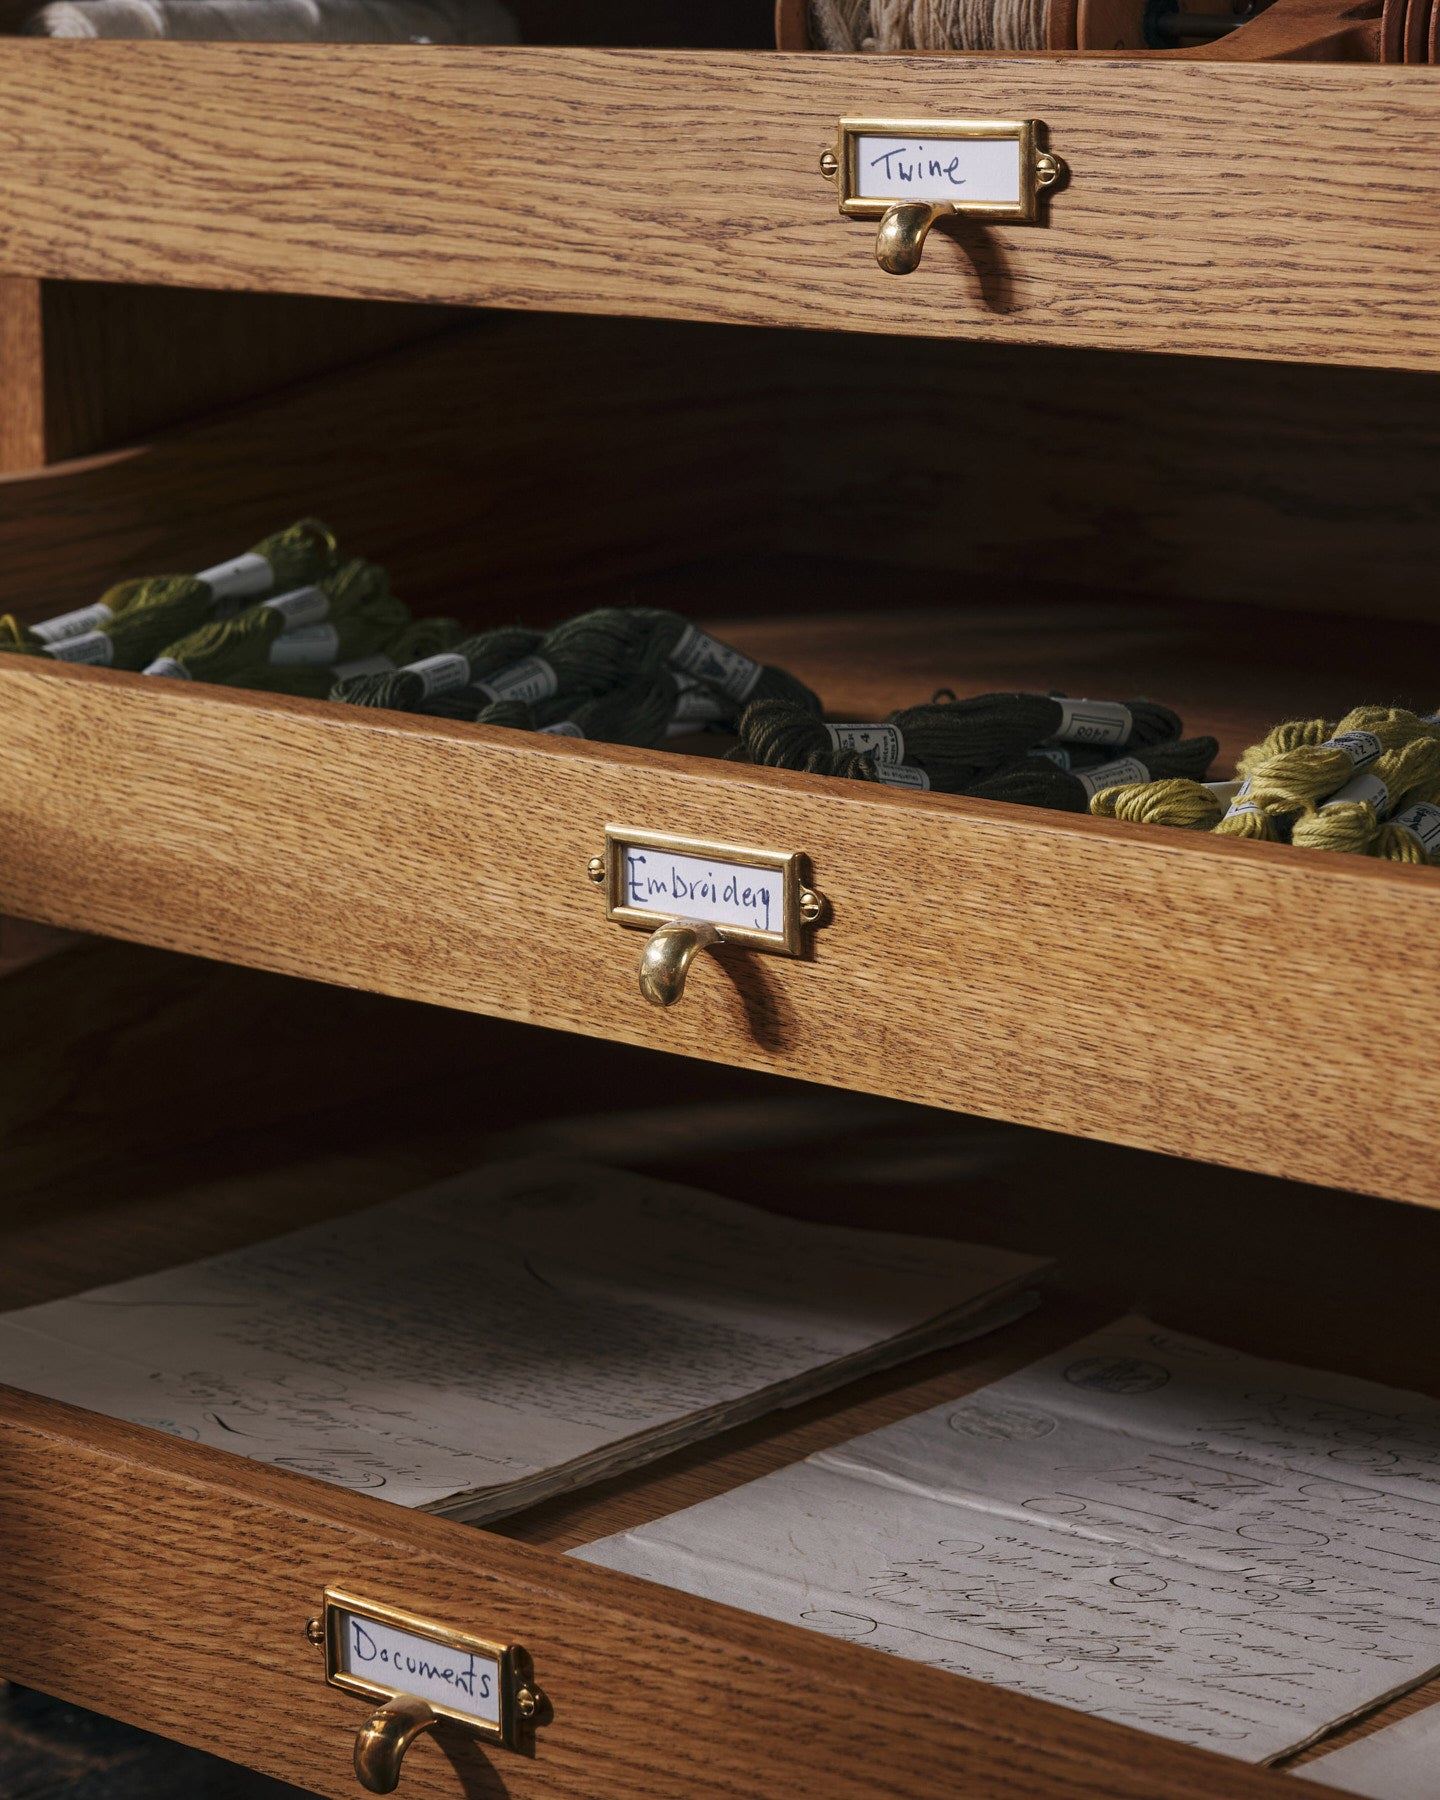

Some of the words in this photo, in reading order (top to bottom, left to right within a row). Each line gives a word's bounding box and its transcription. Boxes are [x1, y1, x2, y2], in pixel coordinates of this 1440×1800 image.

[871, 146, 966, 185] Twine
[627, 855, 770, 930] Embroidery
[351, 1620, 491, 1698] Documents
